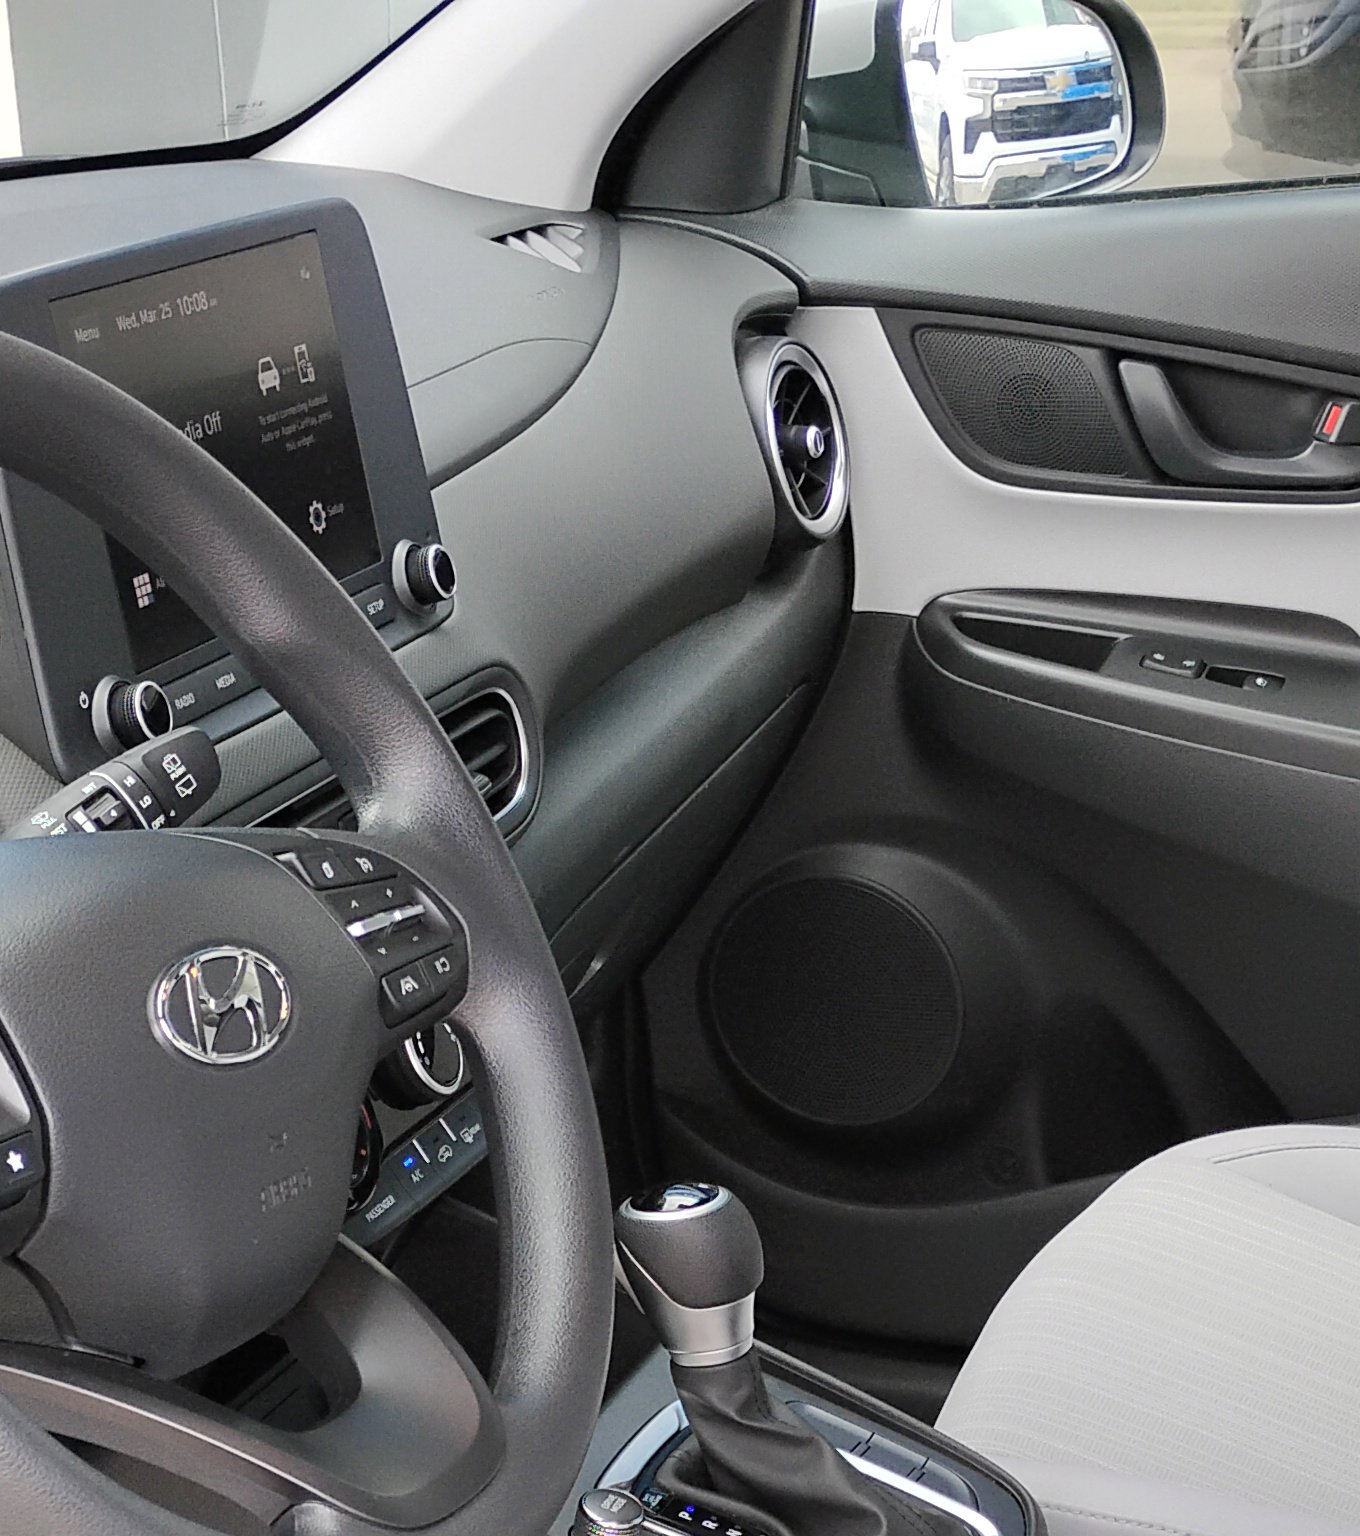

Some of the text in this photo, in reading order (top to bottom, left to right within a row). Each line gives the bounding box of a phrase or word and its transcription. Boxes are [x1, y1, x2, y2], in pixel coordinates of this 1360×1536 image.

[159, 302, 173, 320] 25
[176, 291, 208, 318] 10:08
[74, 326, 100, 343] Menu
[204, 410, 222, 436] Off
[215, 672, 237, 690] MEDIA
[175, 692, 196, 711] RADIO
[139, 795, 152, 809] LO
[151, 814, 166, 830] OFF
[411, 1168, 425, 1183] A/C
[365, 1194, 396, 1223] PASSENGER
[678, 1511, 693, 1521] P
[702, 1519, 719, 1530] R
